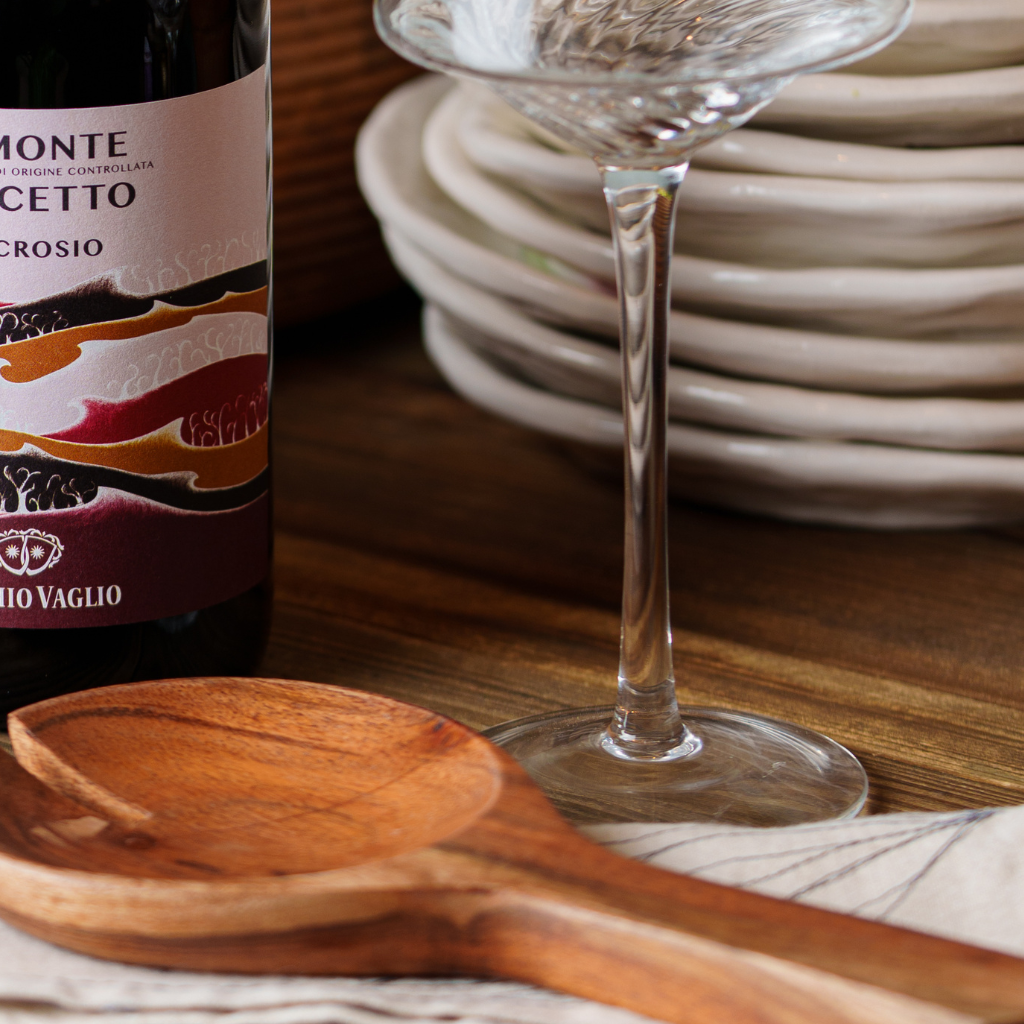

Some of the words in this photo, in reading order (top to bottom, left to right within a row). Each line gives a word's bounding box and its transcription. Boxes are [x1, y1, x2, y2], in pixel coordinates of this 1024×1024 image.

[11, 167, 64, 177] ORIGINE
[67, 159, 155, 177] CONTROLLATA
[35, 584, 123, 610] VAGLIO
